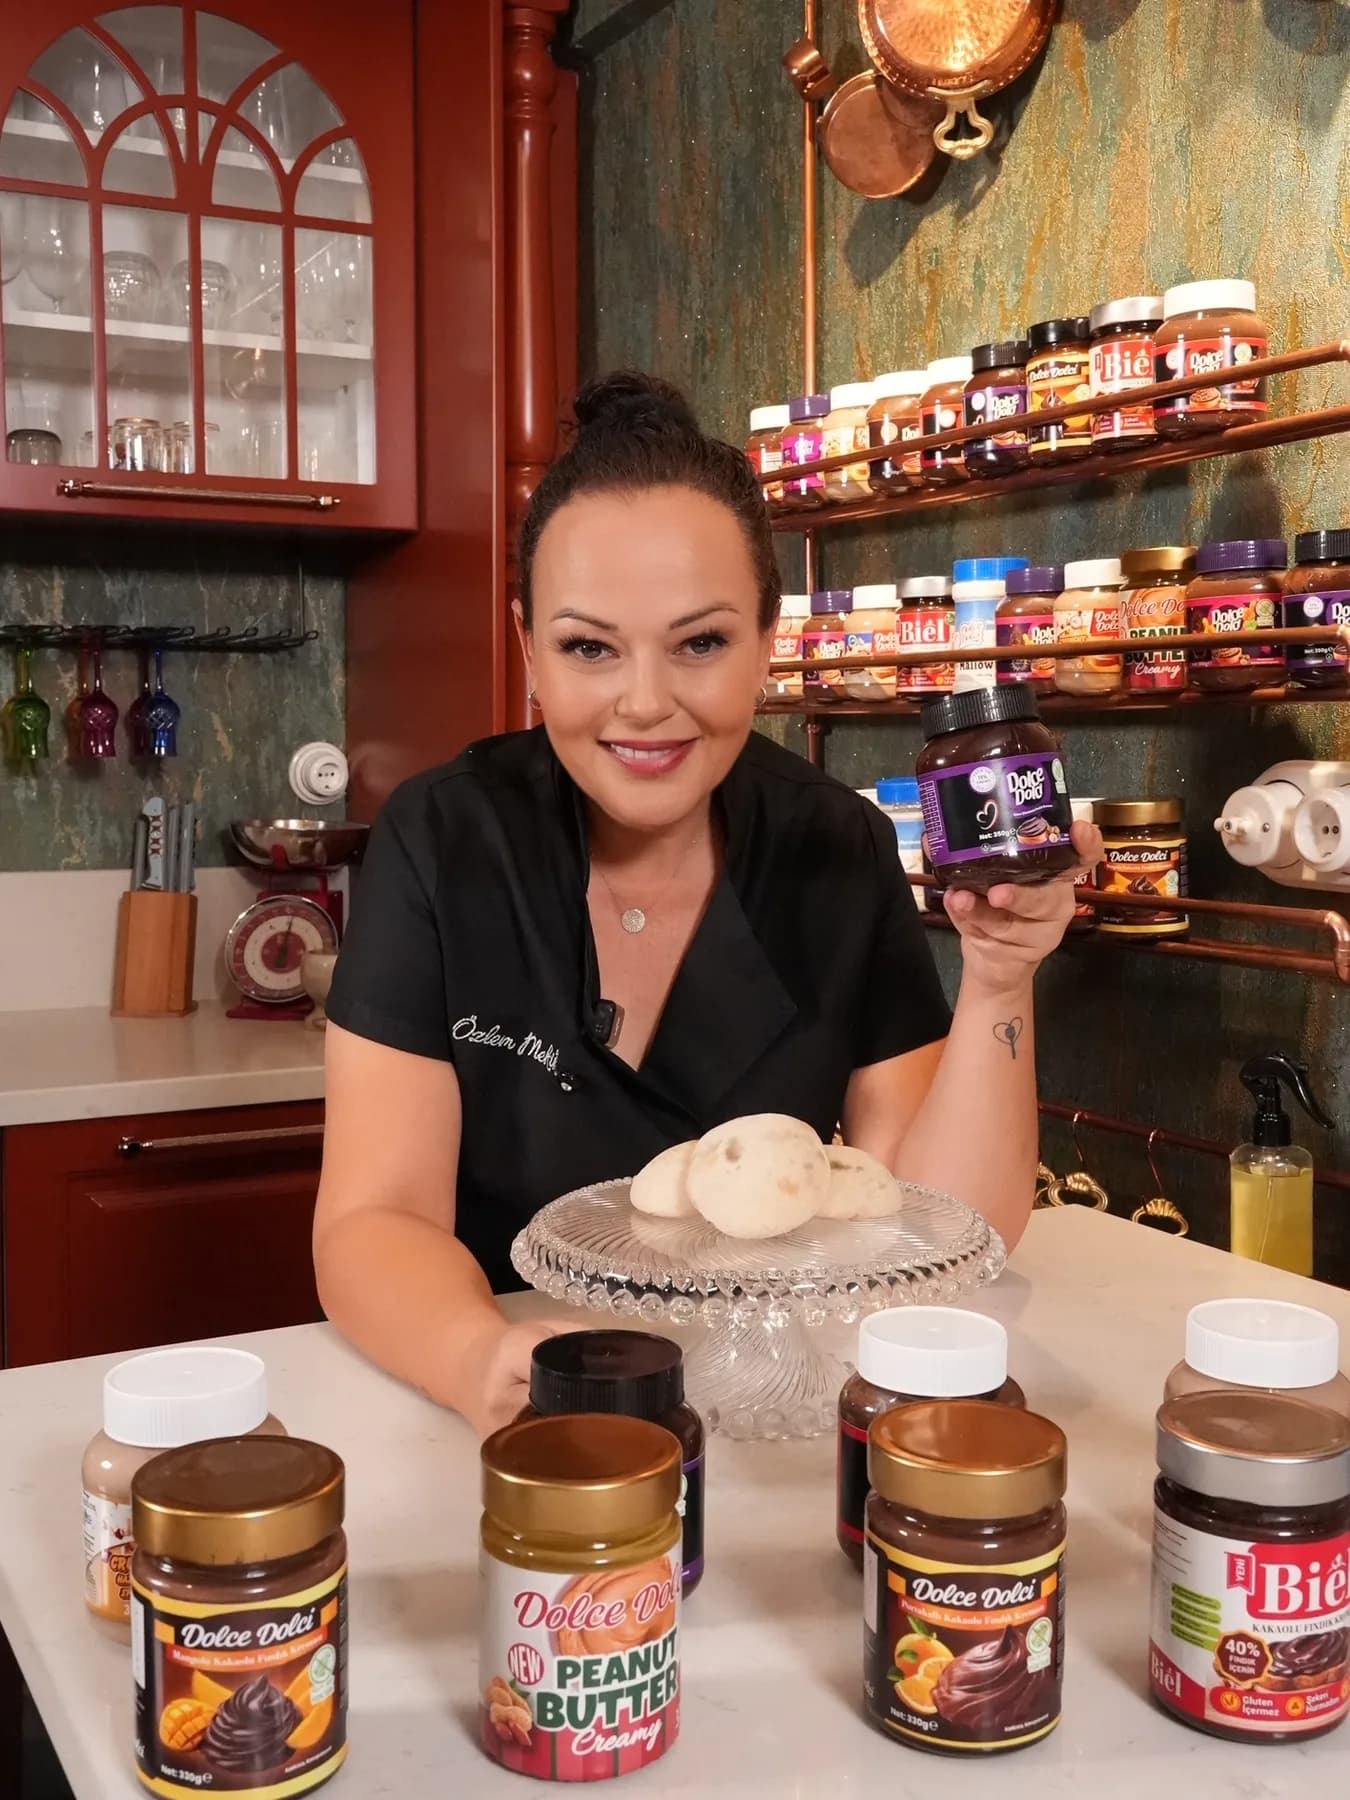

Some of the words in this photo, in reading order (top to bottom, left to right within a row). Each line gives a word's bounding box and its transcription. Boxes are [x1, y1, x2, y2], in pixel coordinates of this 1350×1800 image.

[1332, 602, 1350, 619] Do
[1135, 663, 1181, 679] Creamy
[1006, 767, 1045, 794] Dolce
[1110, 850, 1139, 862] Dolce
[1140, 850, 1168, 862] Dolci
[452, 1015, 516, 1050] Özlem
[912, 1578, 977, 1607] Dolce
[981, 1578, 1037, 1609] Dolci
[513, 1591, 626, 1631] Dolce
[181, 1623, 251, 1649] Dolce
[256, 1607, 316, 1647] Dolci
[510, 1646, 541, 1683] NEW
[557, 1629, 678, 1690] PEANUT
[1225, 1639, 1260, 1657] 40%
[537, 1660, 678, 1729] BUTTER
[1242, 1696, 1273, 1707] Gluten
[572, 1717, 662, 1756] Creamy
